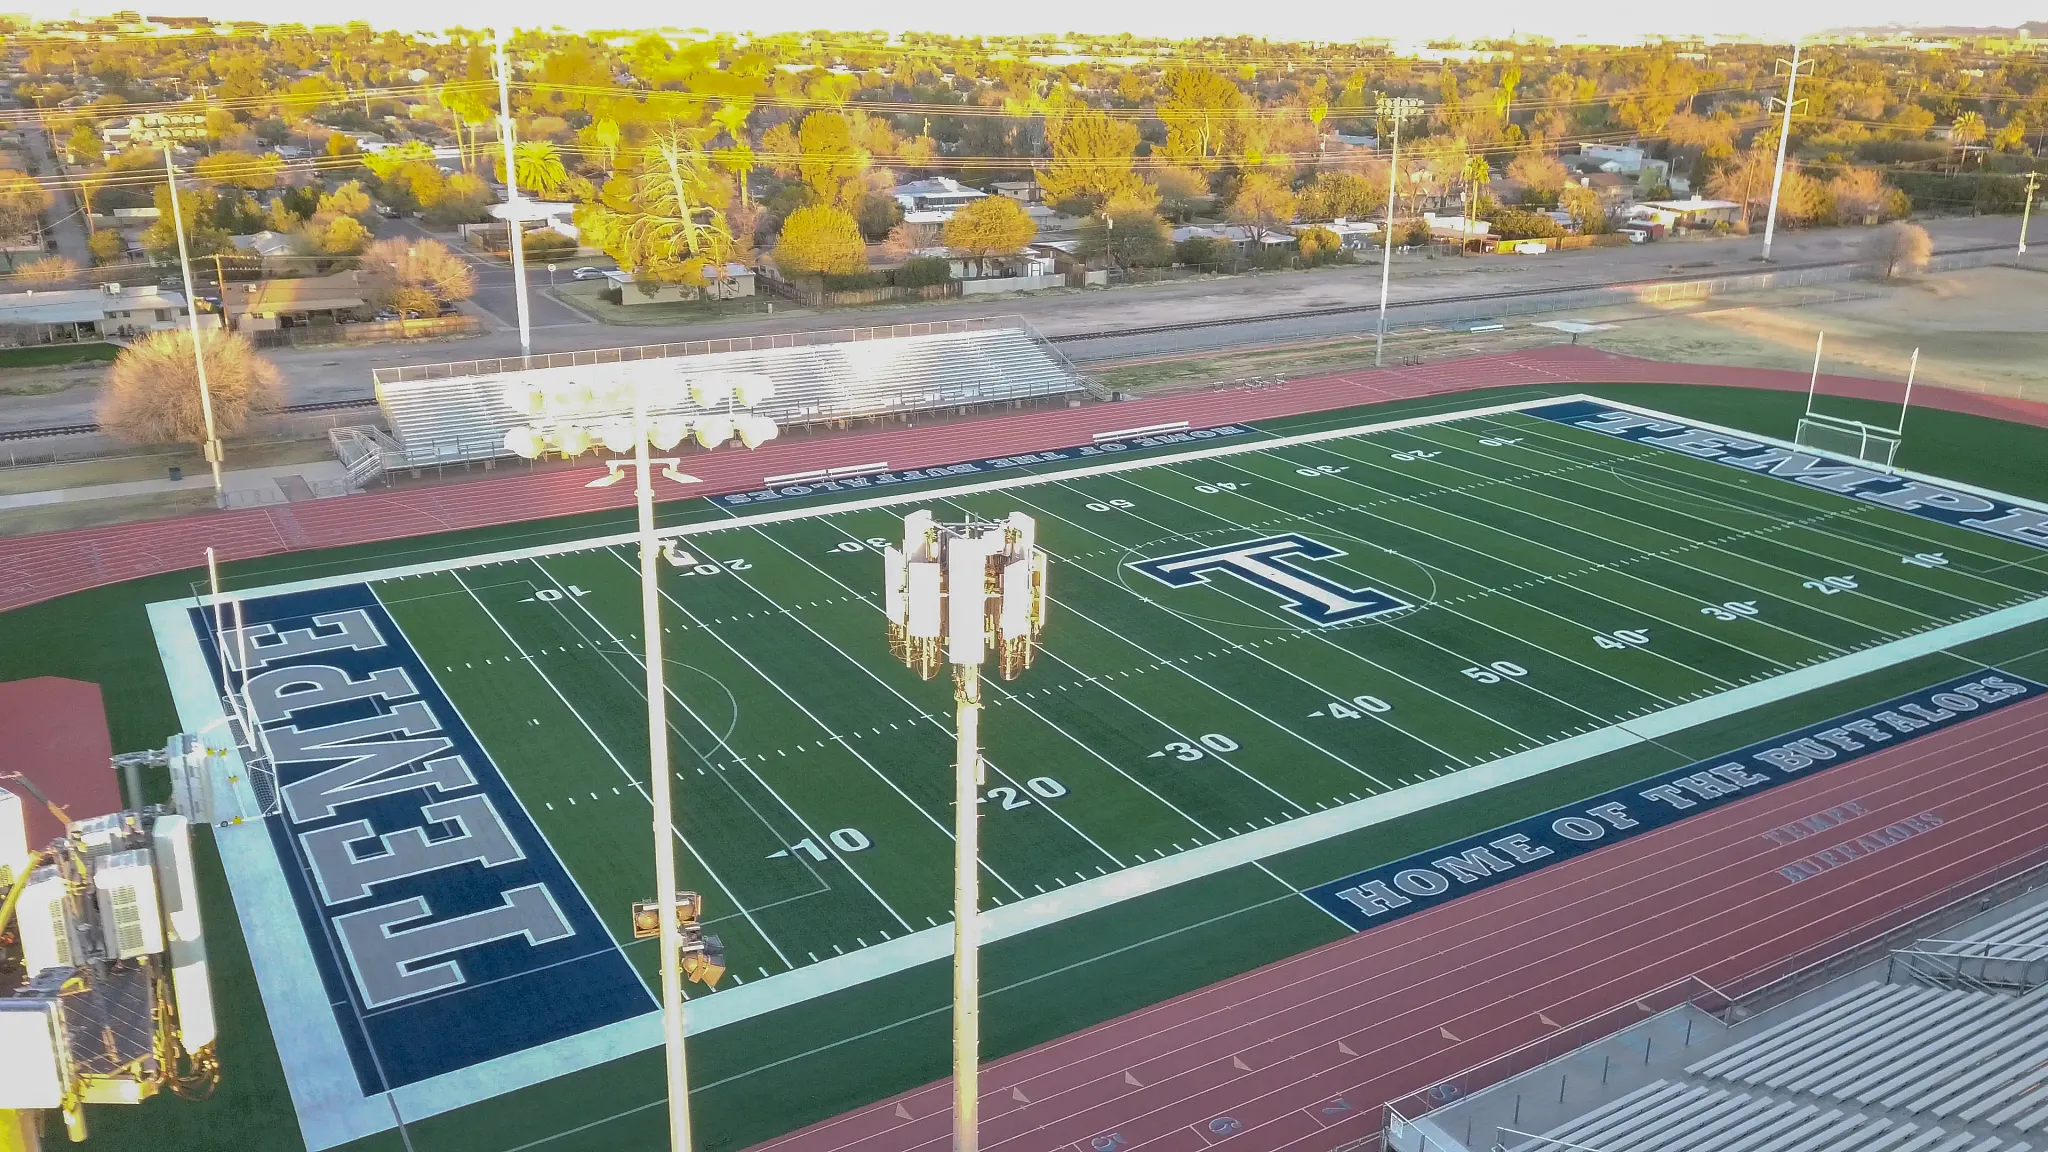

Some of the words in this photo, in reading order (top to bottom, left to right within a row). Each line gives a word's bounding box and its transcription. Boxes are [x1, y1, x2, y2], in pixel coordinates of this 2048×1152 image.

[1133, 425, 1246, 448] HOME
[1478, 437, 1517, 447] 10
[1078, 443, 1129, 456] OF
[1391, 450, 1435, 461] 20
[985, 451, 1069, 469] THE
[1296, 465, 1342, 477] 30
[724, 463, 982, 505] BUFFALOES
[1194, 482, 1241, 495] 40
[1085, 499, 1136, 512] 50
[838, 537, 892, 553] 30
[694, 558, 753, 577] 20
[1902, 553, 1949, 568] 10
[1124, 532, 1416, 627] T
[1803, 576, 1858, 595] 20
[534, 584, 592, 601] 10
[1701, 601, 1759, 621] 30
[1592, 629, 1650, 650] 40
[1460, 661, 1529, 684] 50
[1328, 695, 1393, 720] 40
[1162, 733, 1240, 763] 30
[987, 776, 1069, 811] 20
[1335, 832, 1555, 917] HOME
[1551, 801, 1640, 841] OF
[1638, 762, 1771, 810] THE
[1753, 676, 2028, 773] BUFFALOES
[216, 609, 577, 1010] TEMPE
[1761, 801, 1871, 847] TEMPE
[790, 828, 872, 862] 10
[1775, 812, 1946, 885] BUFFALOES
